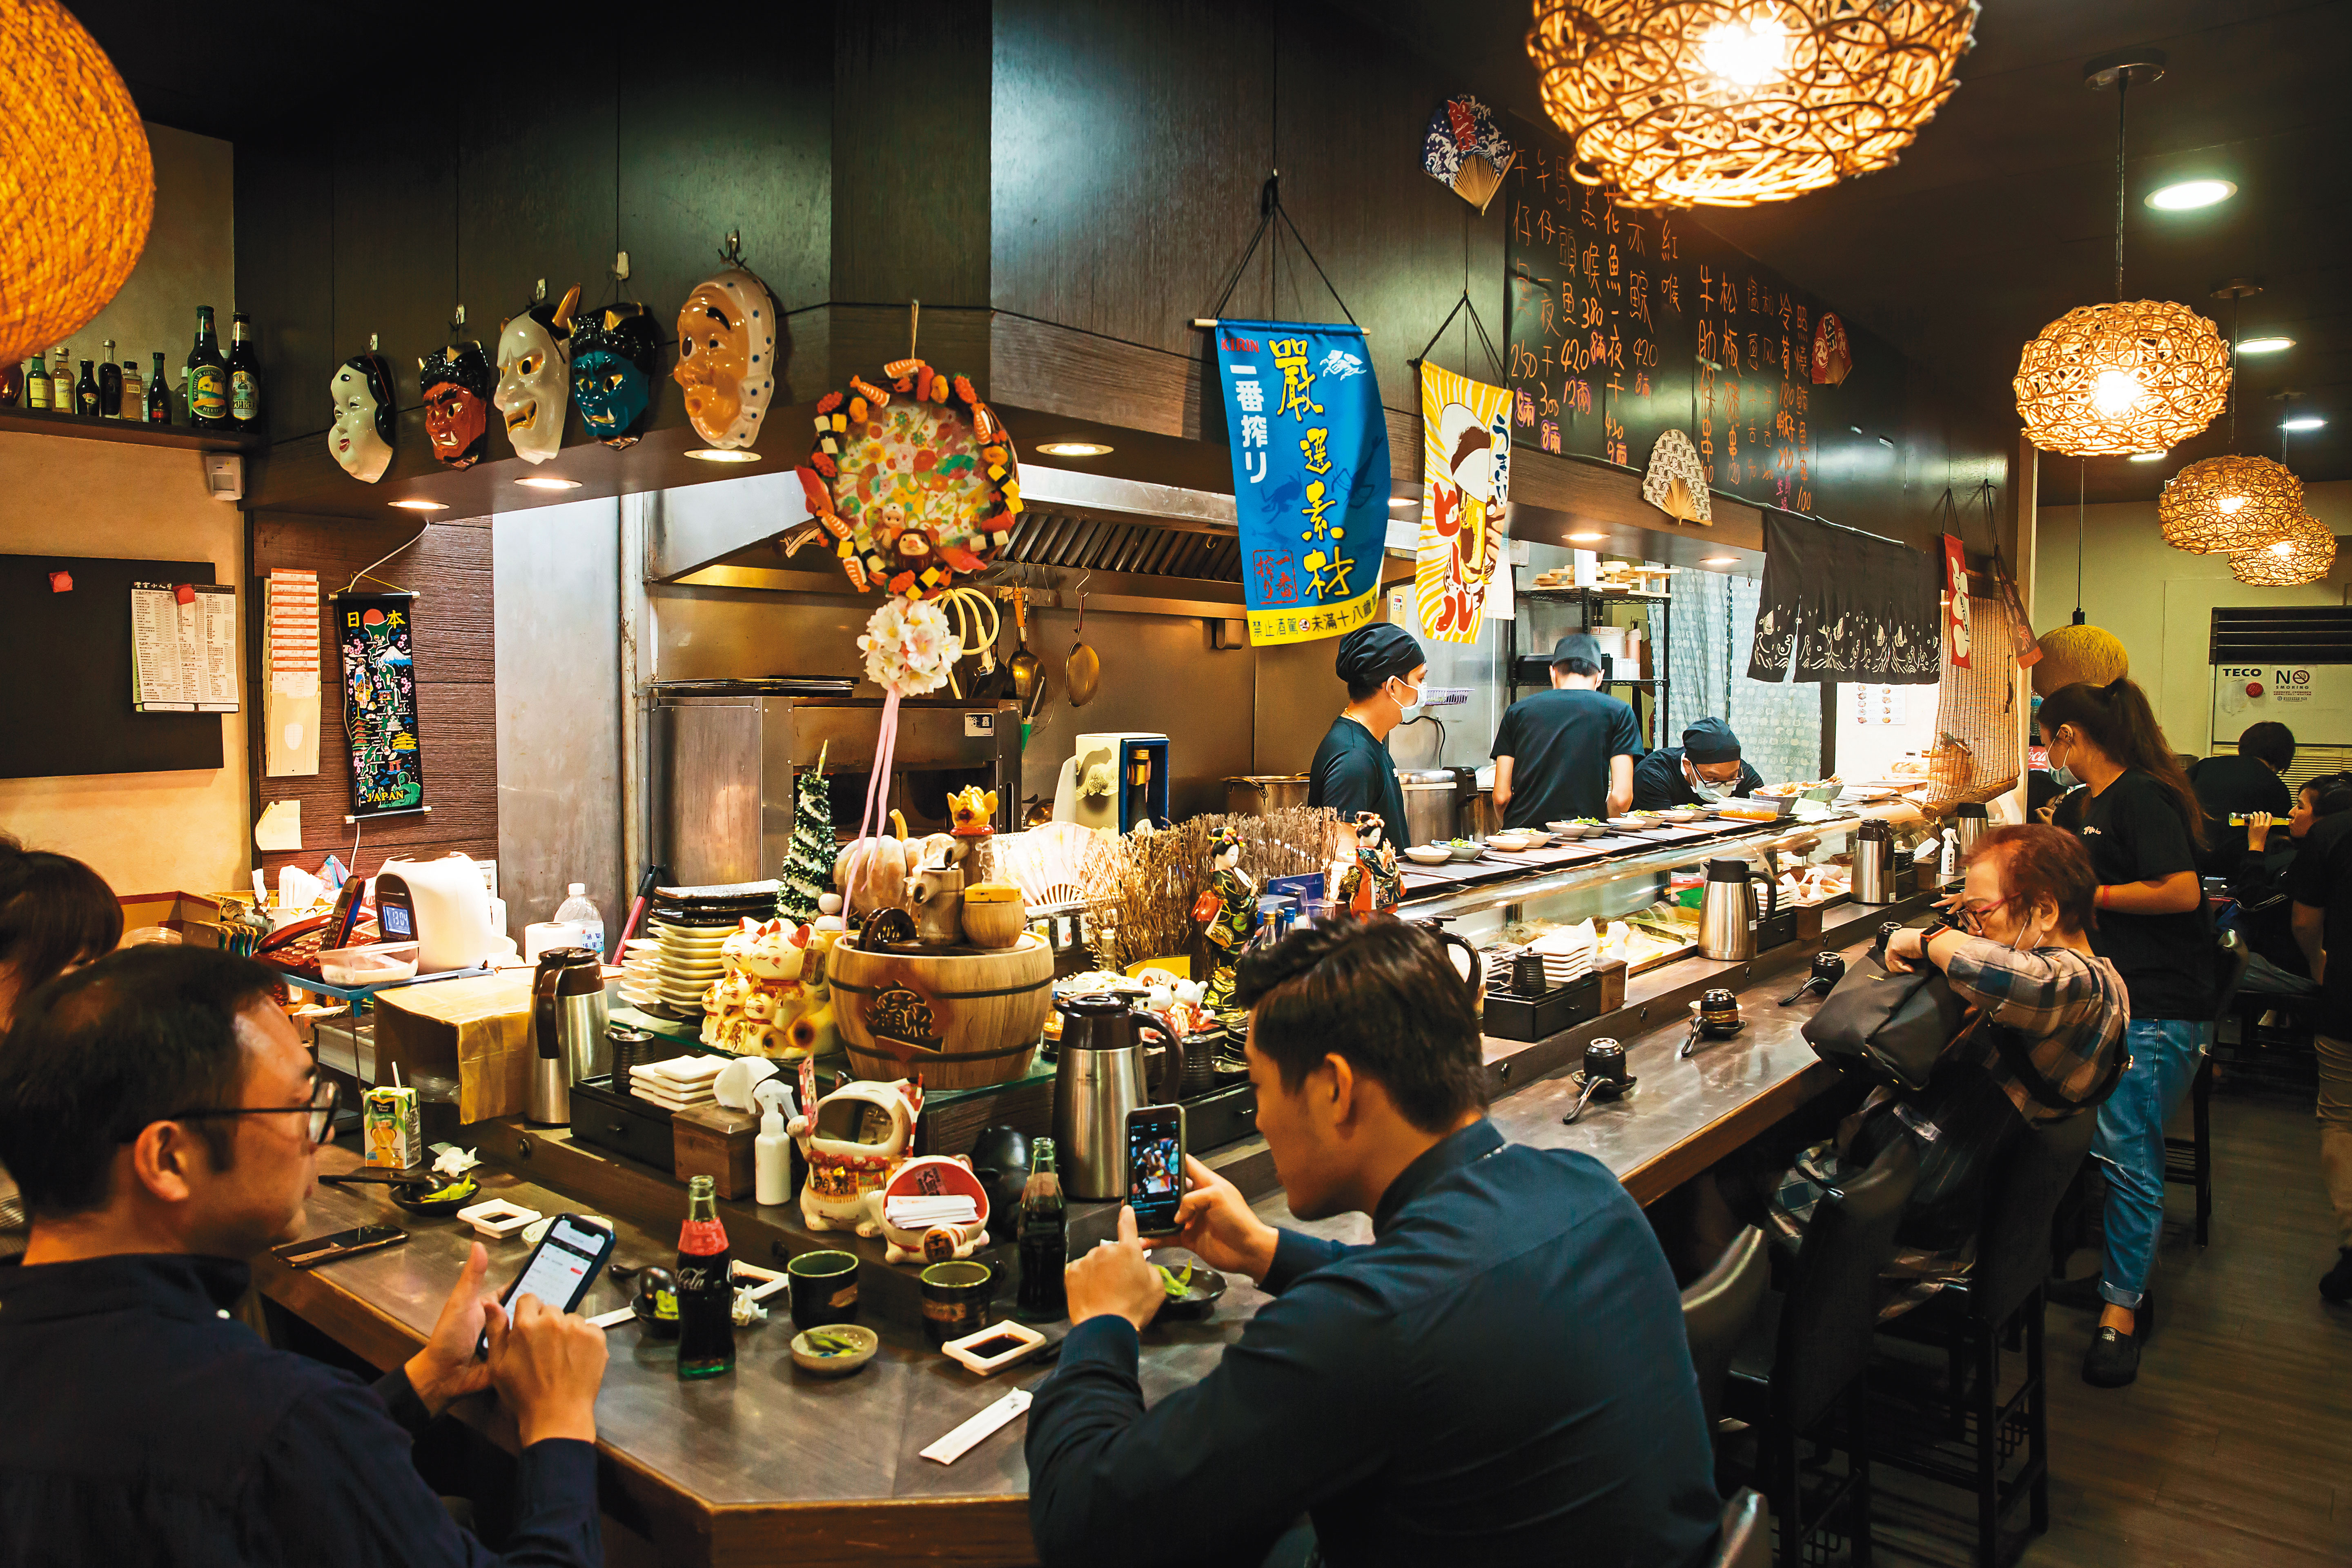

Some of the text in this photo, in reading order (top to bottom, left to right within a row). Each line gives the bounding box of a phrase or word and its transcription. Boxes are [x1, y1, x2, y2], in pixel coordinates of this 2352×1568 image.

[1581, 297, 1604, 329] 380
[1221, 337, 1260, 353] KIRIN
[1511, 339, 1537, 379] 250
[1561, 339, 1590, 374] 420
[1633, 338, 1658, 367] 420
[194, 372, 203, 399] PREMIUM
[1779, 380, 1795, 408] 180
[1229, 364, 1268, 484] 一番搾り
[1268, 337, 1356, 599] 嚴選素材
[1797, 486, 1811, 512] 100
[1252, 618, 1298, 637] 禁止酒駕
[2223, 668, 2262, 677] TECO
[367, 790, 404, 803] JAPAN
